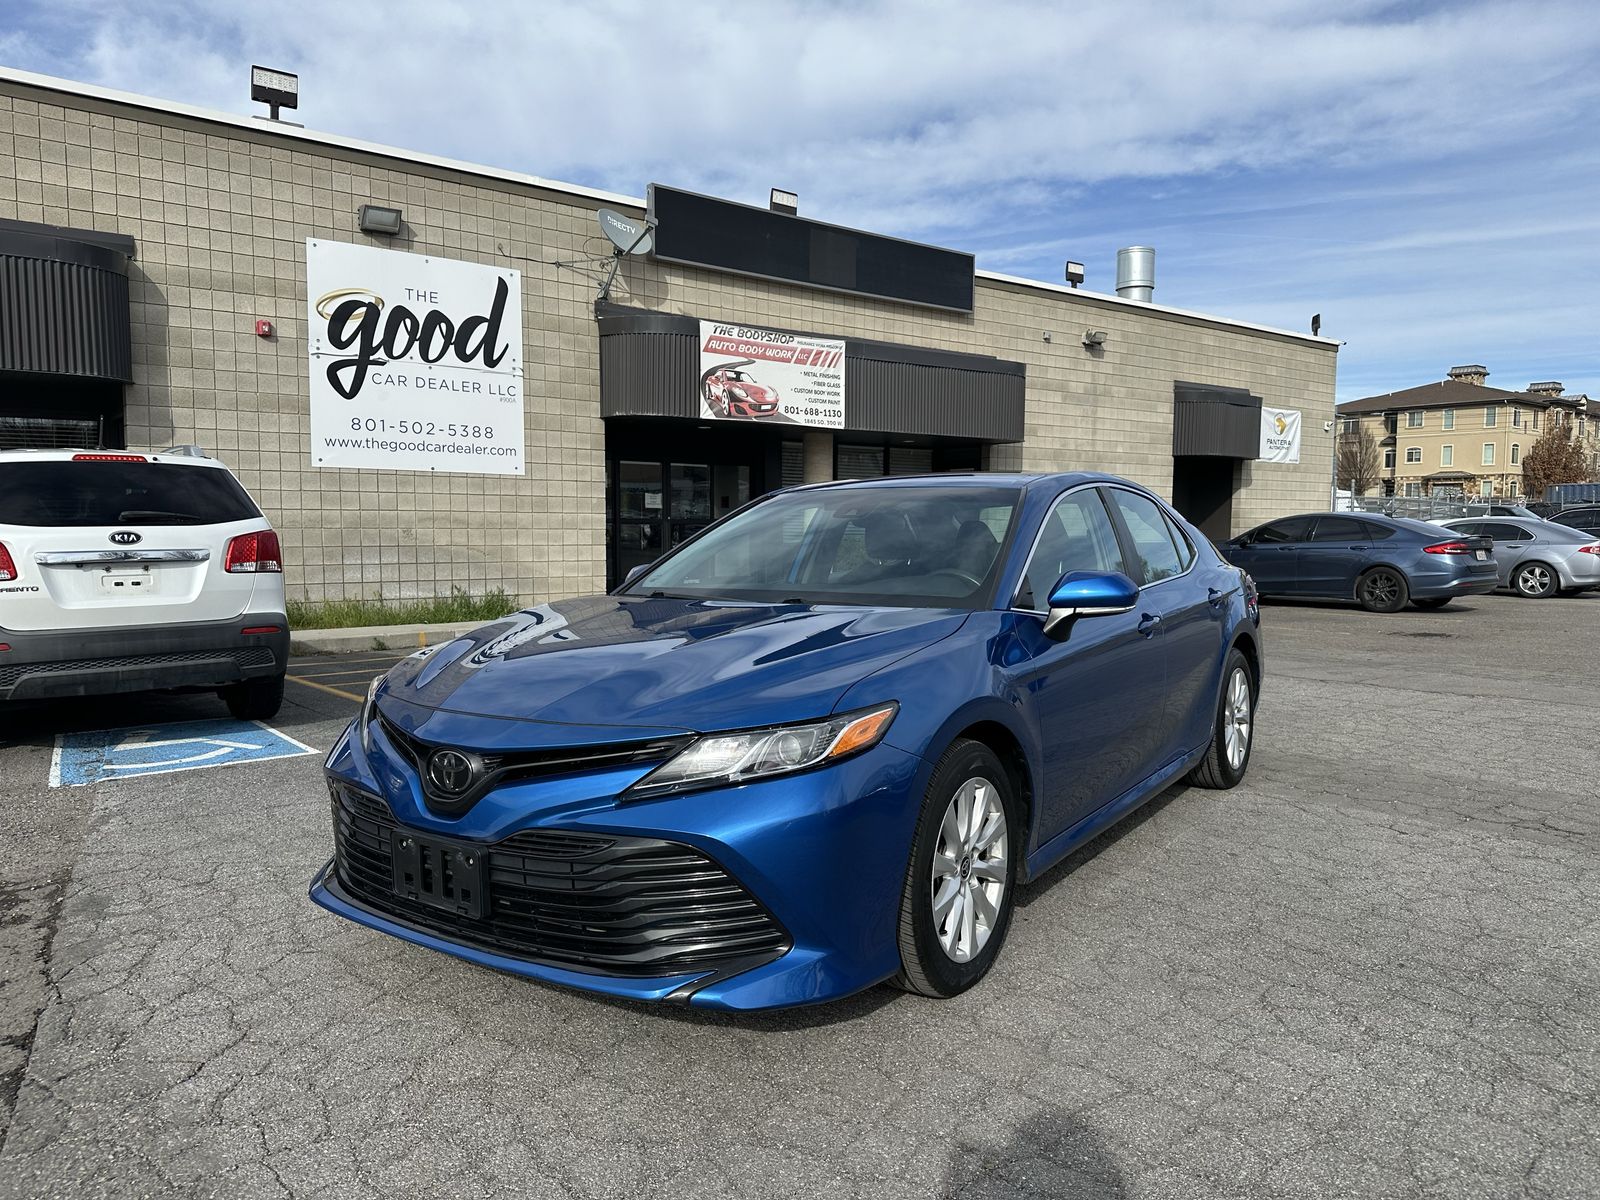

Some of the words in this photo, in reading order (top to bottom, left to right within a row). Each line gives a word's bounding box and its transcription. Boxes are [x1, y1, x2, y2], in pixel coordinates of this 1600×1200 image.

[607, 215, 636, 234] DIRECTV
[405, 288, 439, 304] THE
[326, 276, 509, 400] good
[713, 325, 734, 336] THE
[738, 329, 794, 344] BODYSHOP
[708, 340, 736, 351] AUTO
[738, 344, 764, 354] BODY
[766, 348, 794, 359] WORK
[372, 372, 408, 387] CAR
[416, 377, 482, 394] DEALER
[488, 384, 517, 397] LLC
[784, 406, 842, 417] 801-688-1130
[351, 418, 494, 439] 801-502-5388
[325, 436, 517, 456] www.thegoodcardealer.com
